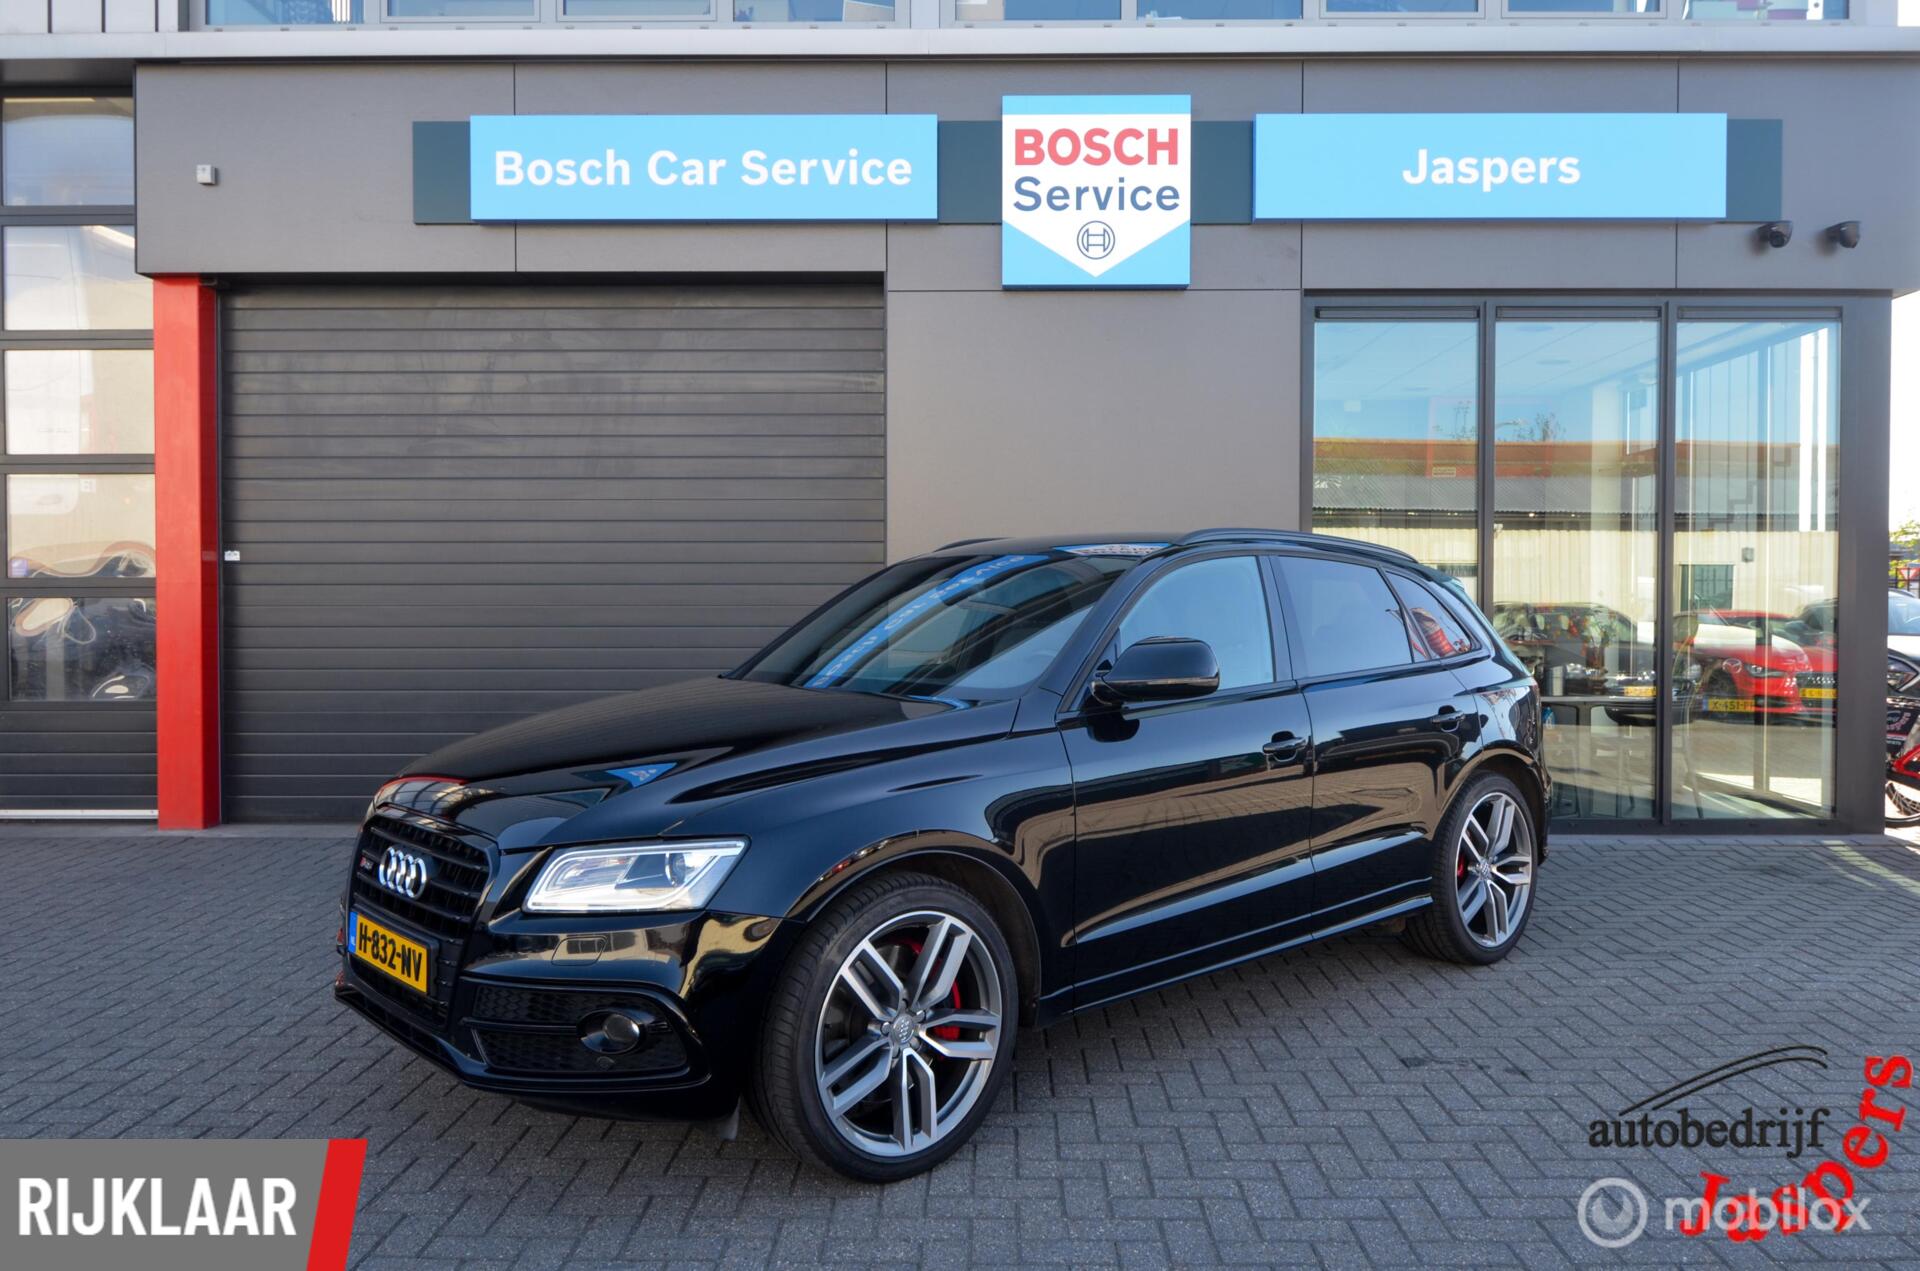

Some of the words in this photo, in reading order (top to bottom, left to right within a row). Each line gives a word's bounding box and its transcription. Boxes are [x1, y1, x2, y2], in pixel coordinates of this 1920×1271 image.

[1015, 127, 1178, 166] BOSCH
[495, 149, 630, 186] Bosch
[647, 150, 727, 186] Car
[741, 149, 913, 186] Service
[1402, 148, 1582, 192] Jaspers
[1013, 176, 1180, 212] Service
[358, 922, 423, 982] H-832-NV
